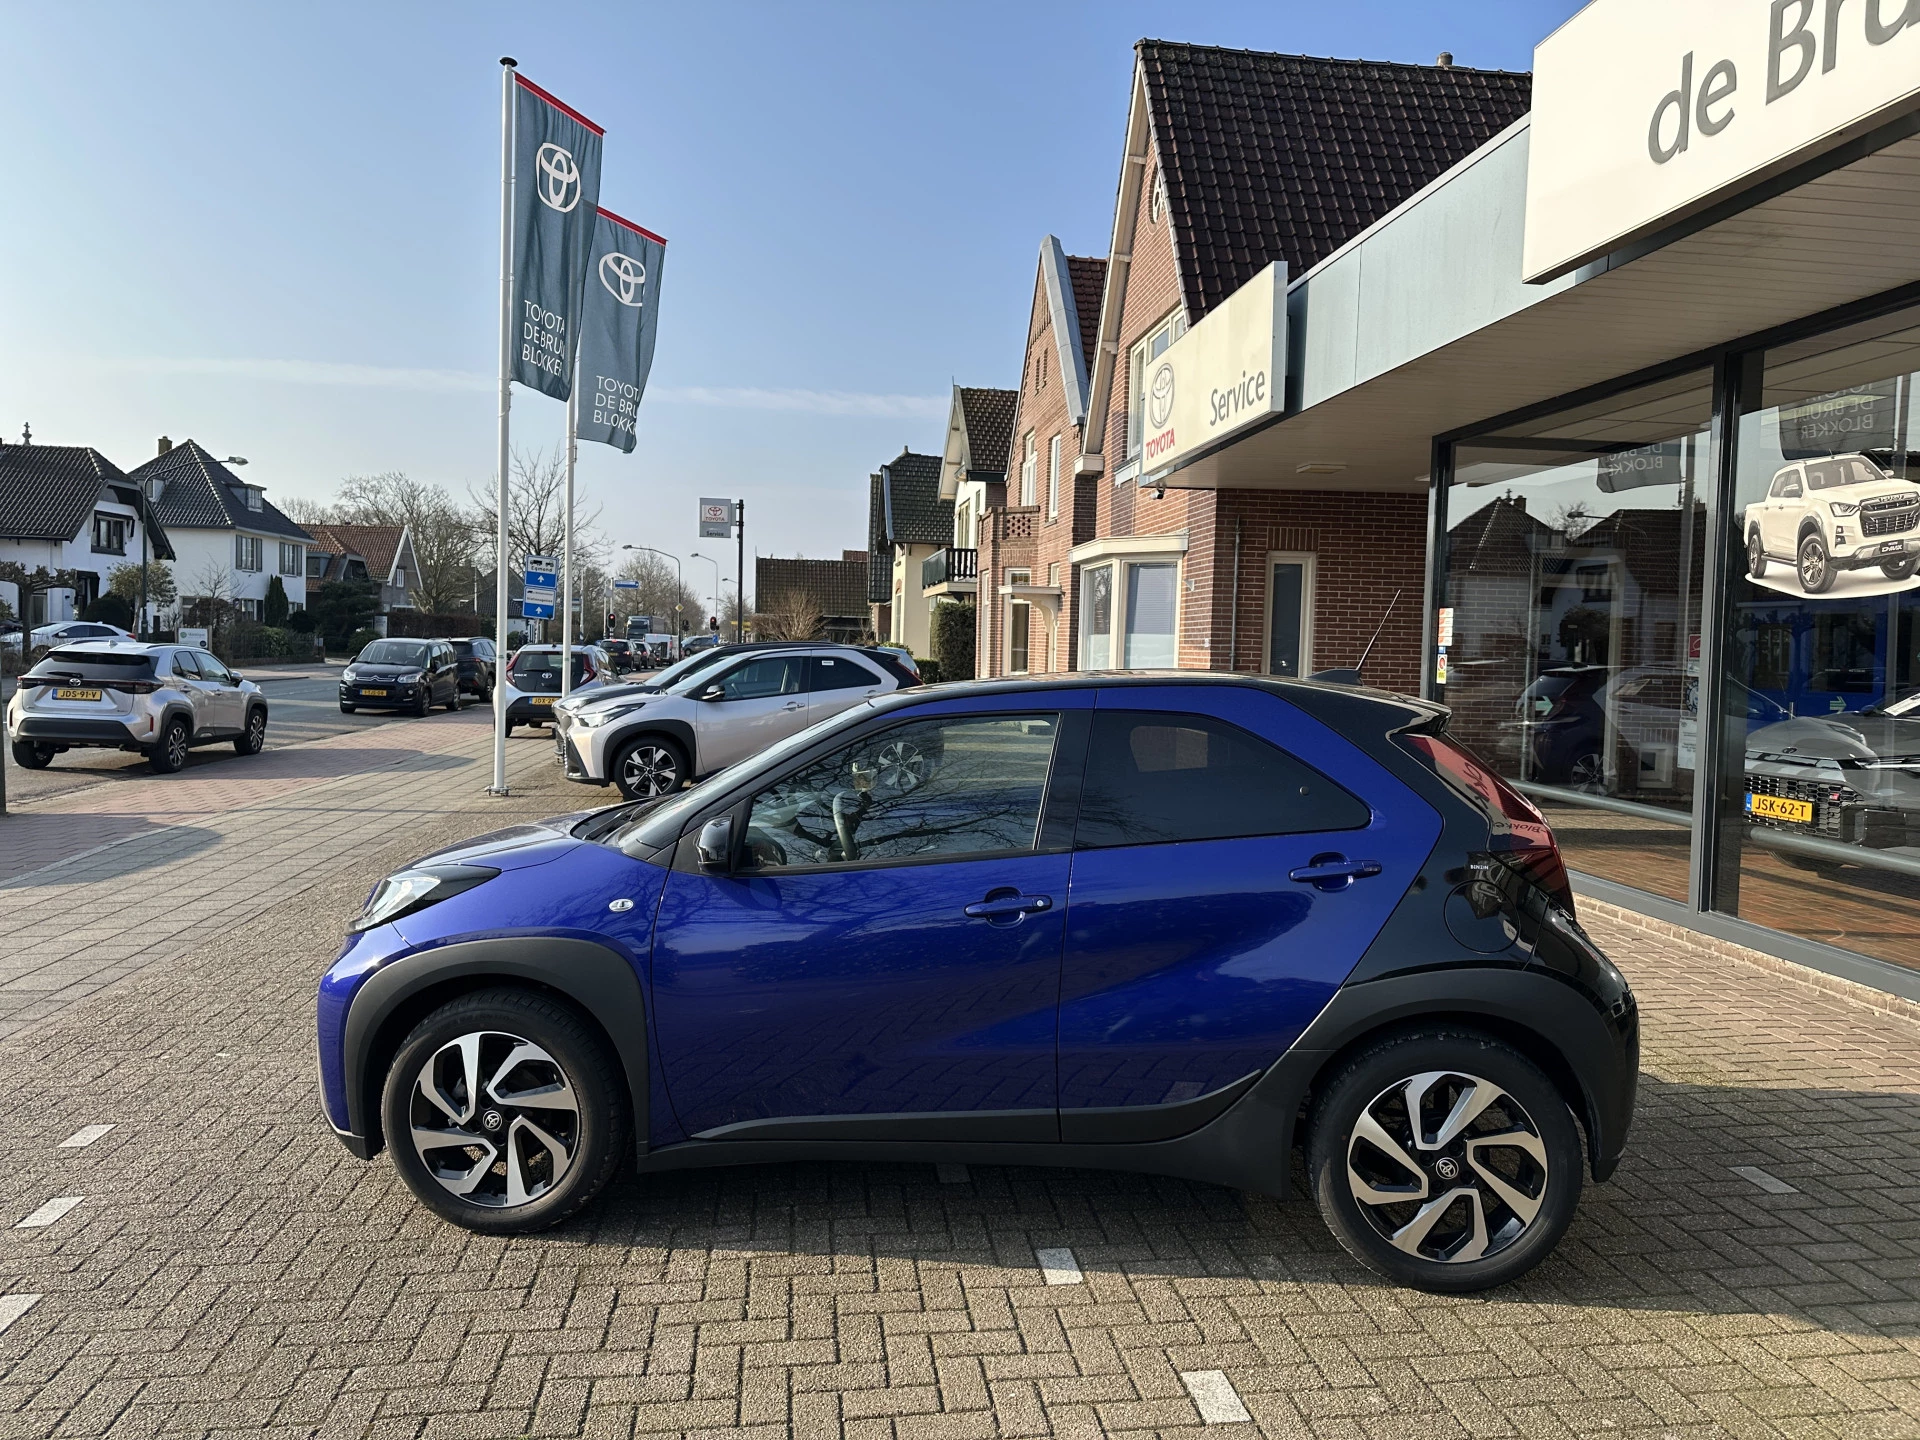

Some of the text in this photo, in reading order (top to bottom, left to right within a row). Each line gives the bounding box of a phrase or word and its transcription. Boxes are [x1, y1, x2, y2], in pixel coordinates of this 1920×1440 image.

[1648, 50, 1738, 164] de
[524, 300, 565, 336] TOYOTA
[595, 392, 616, 409] DE
[1209, 370, 1266, 426] Service
[1145, 427, 1176, 461] TOYOTA
[60, 690, 97, 699] JDS-91-V
[1755, 798, 1807, 818] JSK-62-T
